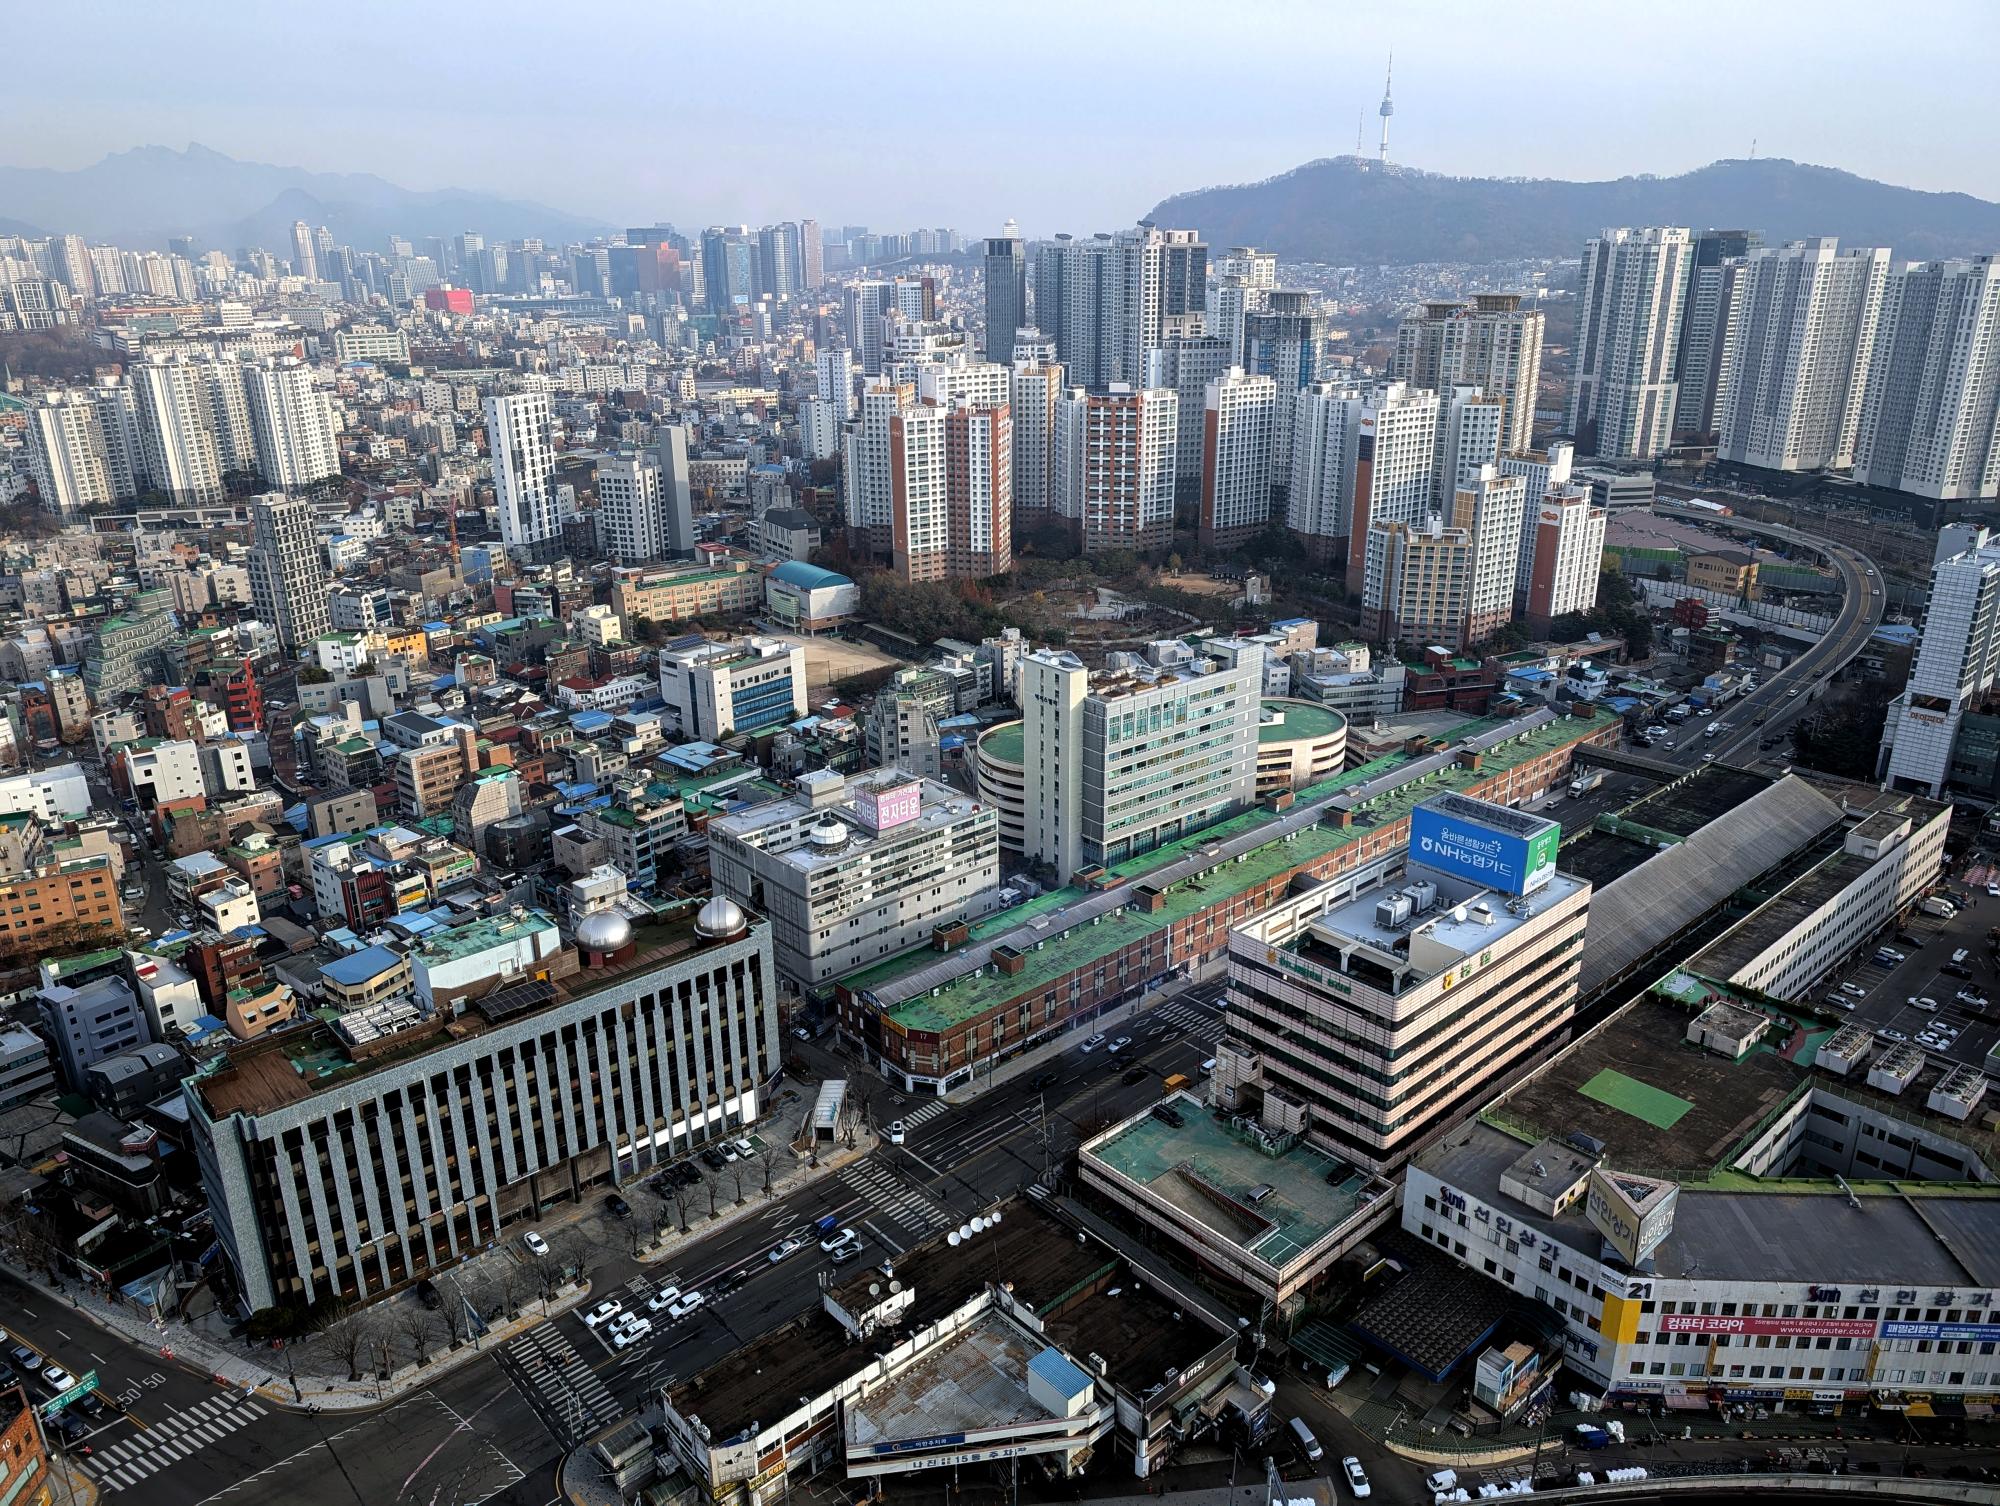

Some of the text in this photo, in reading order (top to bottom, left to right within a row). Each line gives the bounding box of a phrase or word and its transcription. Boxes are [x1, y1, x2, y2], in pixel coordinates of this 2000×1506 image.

[881, 797, 918, 824] 전자타운
[1434, 842, 1512, 876] NH농협카드
[1590, 1191, 1636, 1249] 선인상가
[1639, 1206, 1675, 1252] 선인상가
[1474, 1206, 1560, 1260] 선인상가
[1628, 1282, 1653, 1299] 21
[1859, 1288, 1993, 1308] 선인상가
[1667, 1317, 1744, 1332] 컴퓨터 코리아
[1780, 1327, 1871, 1336] www.computer.co.kr
[1187, 1360, 1206, 1380] msi
[142, 1372, 167, 1389] 50
[117, 1387, 142, 1405] 50
[768, 1461, 785, 1476] CCTV
[913, 1458, 937, 1469] 나진
[955, 1453, 980, 1464] 15동
